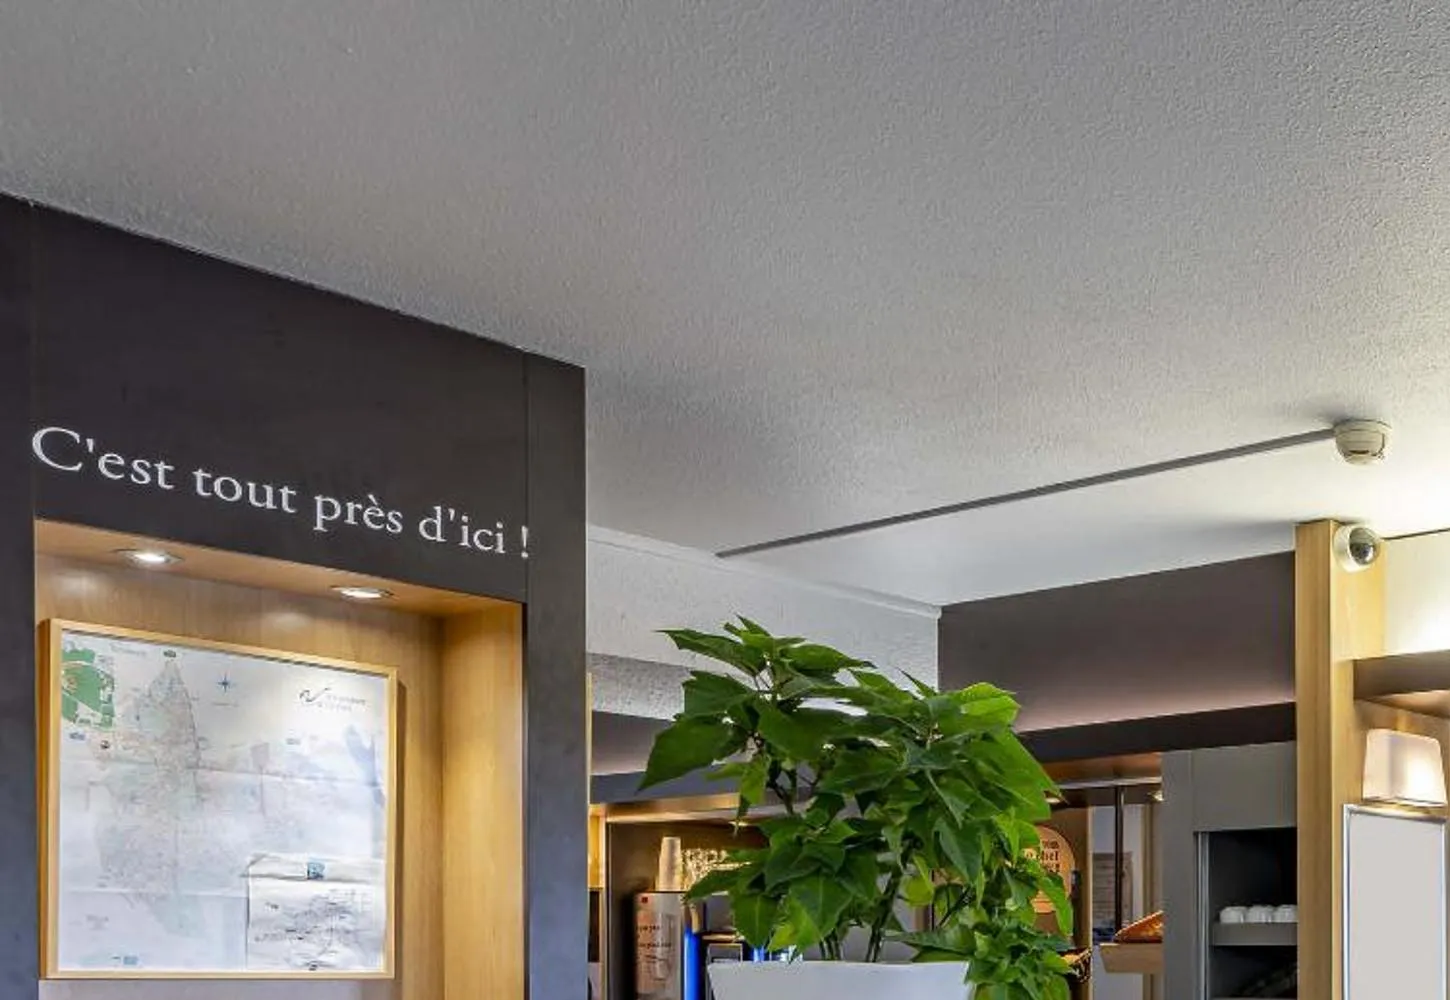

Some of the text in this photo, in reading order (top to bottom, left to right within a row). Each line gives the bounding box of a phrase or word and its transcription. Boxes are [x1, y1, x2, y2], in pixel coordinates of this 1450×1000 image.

[32, 427, 175, 490] C'est
[192, 468, 297, 514] tout
[313, 494, 403, 533] près
[418, 506, 506, 554] d'ici
